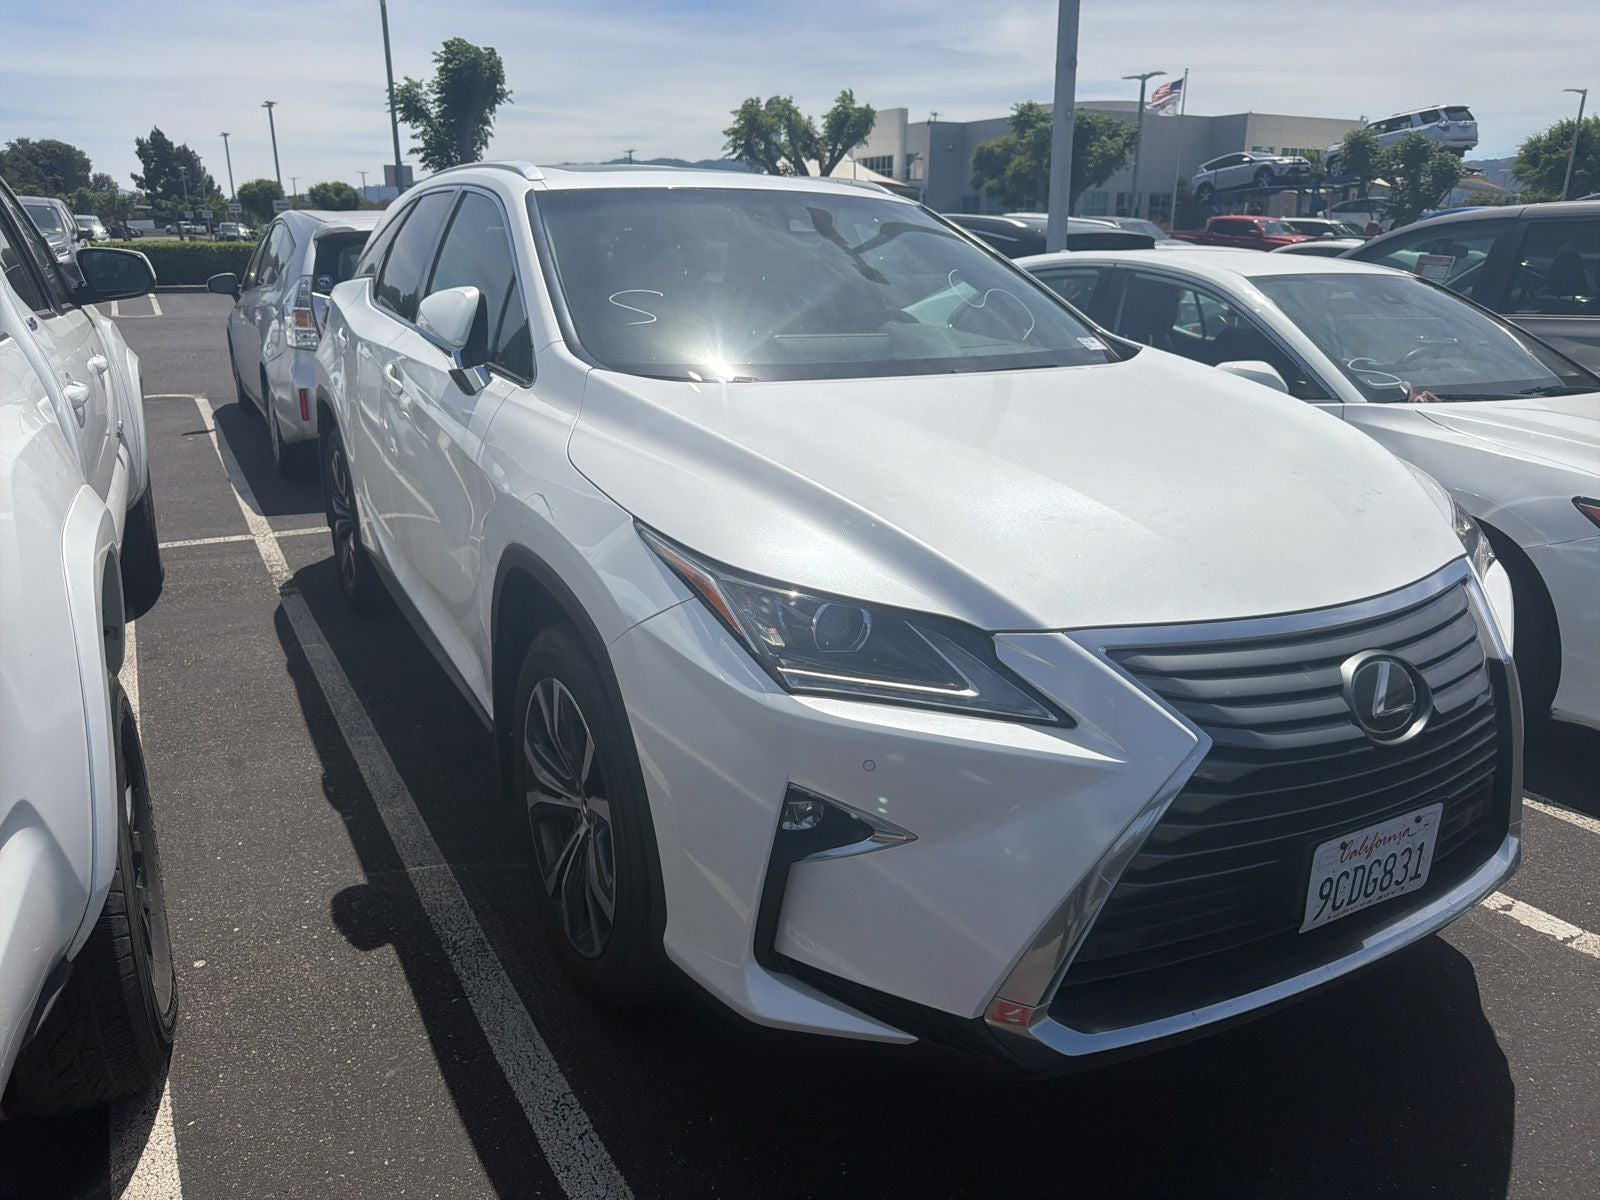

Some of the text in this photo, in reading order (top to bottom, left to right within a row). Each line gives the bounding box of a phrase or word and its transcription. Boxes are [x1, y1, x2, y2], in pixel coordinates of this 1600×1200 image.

[608, 289, 664, 326] S
[1340, 823, 1418, 864] California
[1313, 842, 1424, 921] 9CDG831
